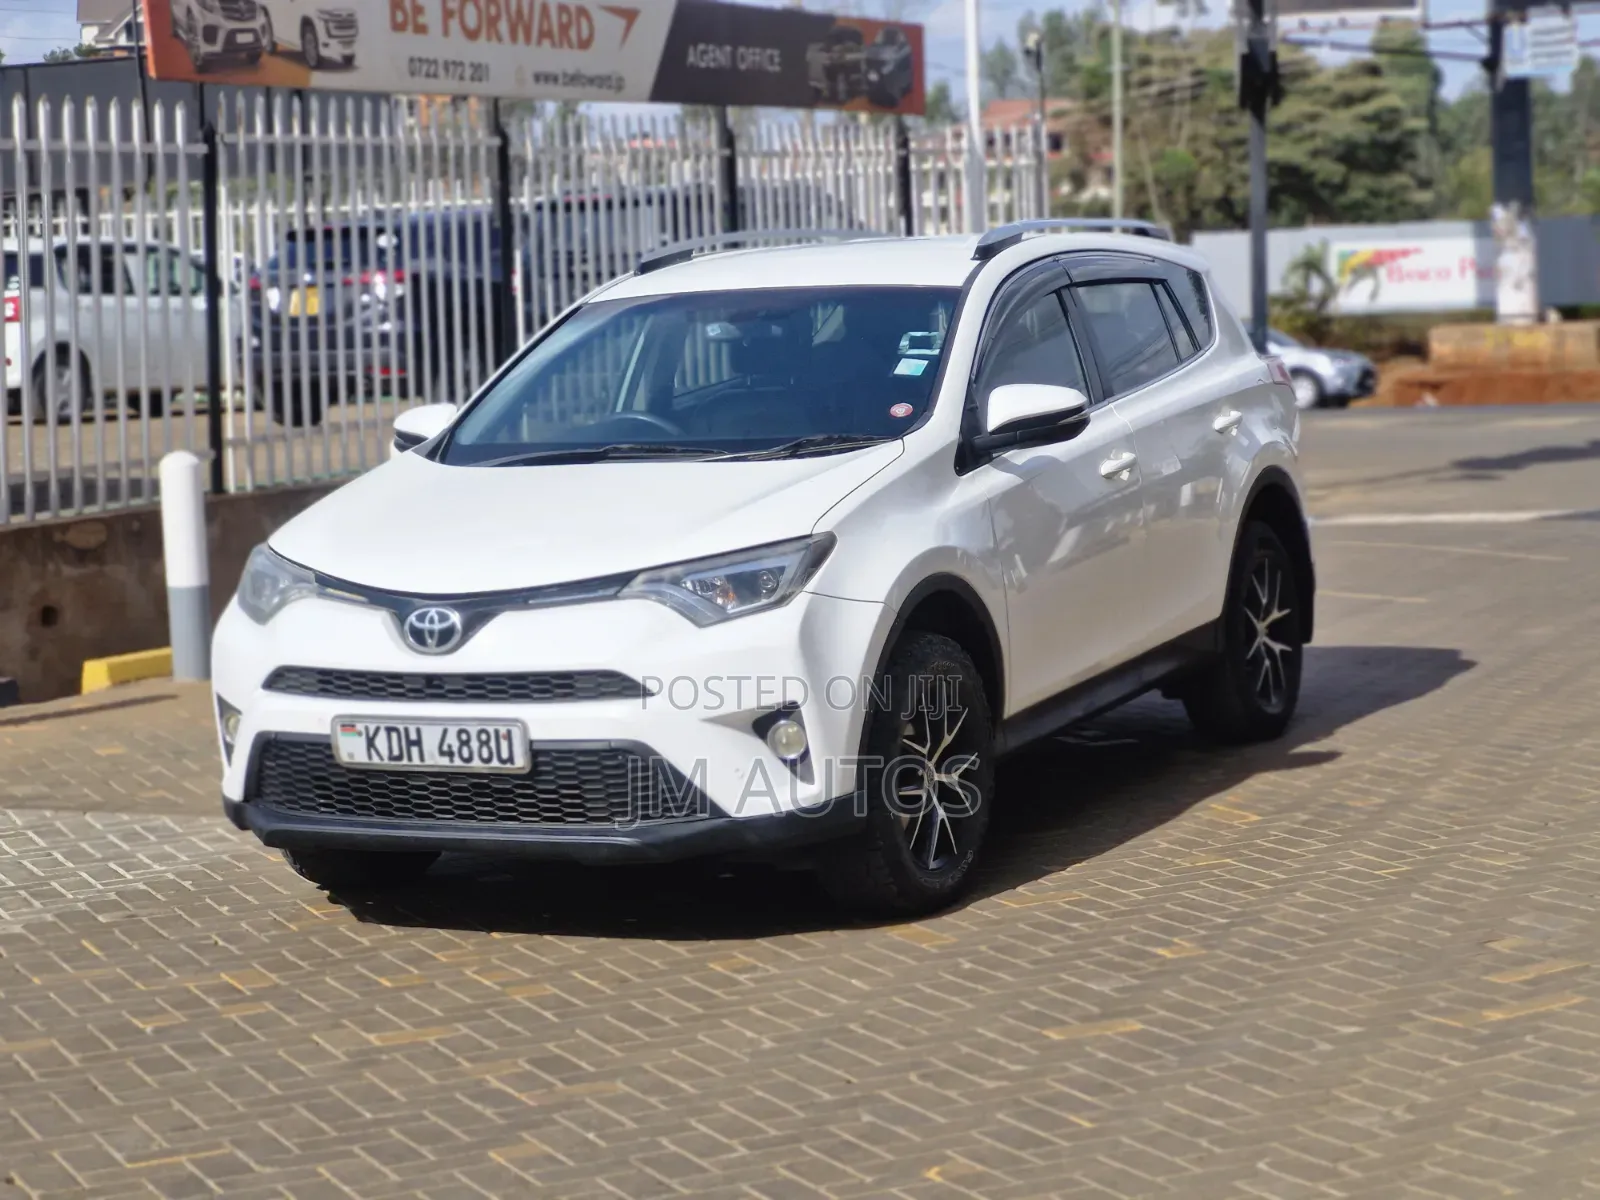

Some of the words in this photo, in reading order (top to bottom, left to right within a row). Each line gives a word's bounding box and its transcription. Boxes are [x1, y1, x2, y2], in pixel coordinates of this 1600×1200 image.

[389, 0, 429, 36] BE
[441, 0, 596, 51] FORWARD
[408, 56, 439, 79] 0722
[443, 59, 466, 82] 972
[469, 61, 490, 83] 201
[686, 43, 732, 69] AGENT
[736, 45, 782, 72] OFFICE
[364, 725, 425, 763] KDH
[437, 727, 515, 766] 488U
